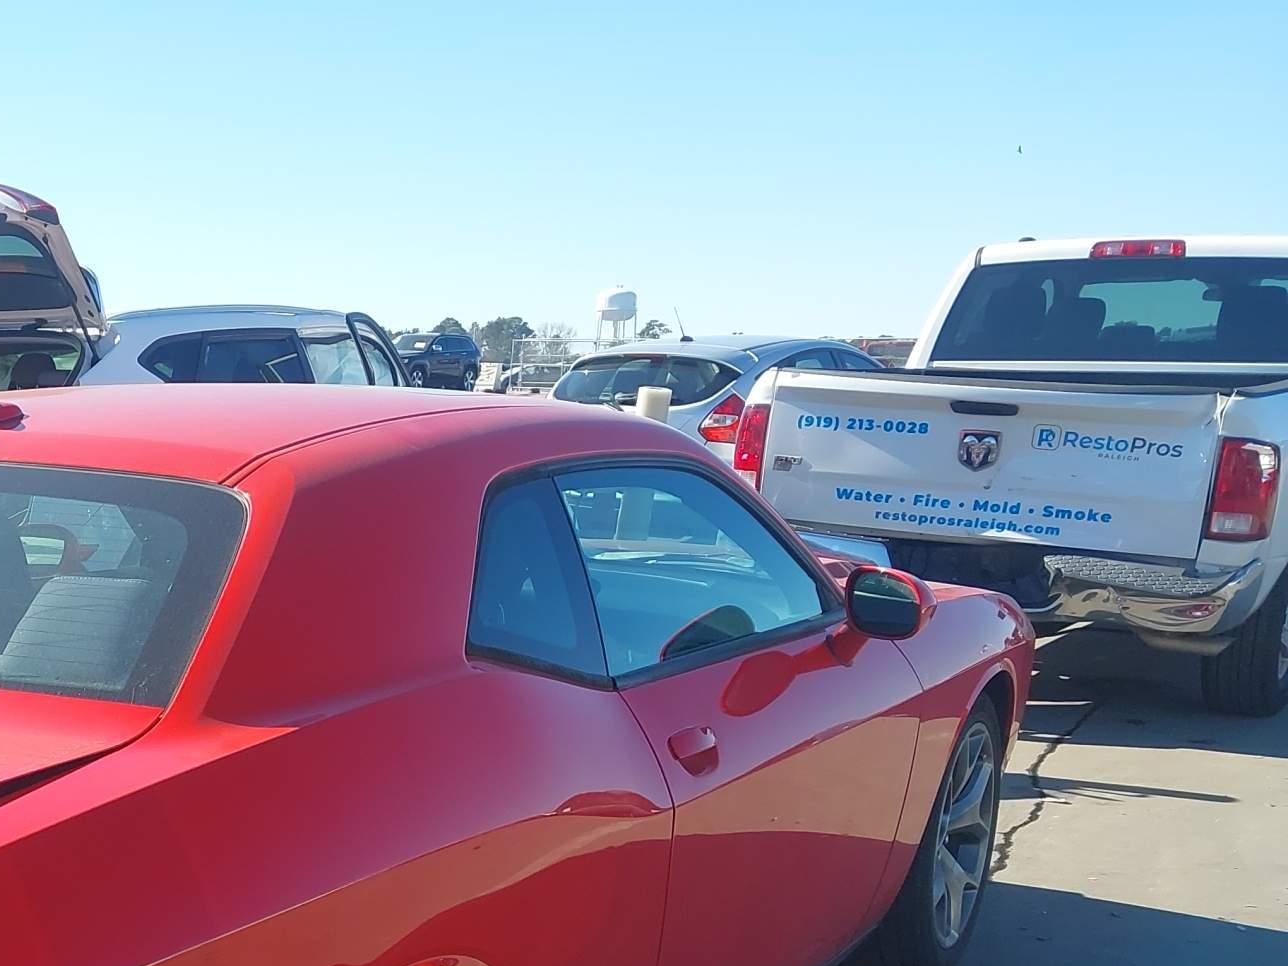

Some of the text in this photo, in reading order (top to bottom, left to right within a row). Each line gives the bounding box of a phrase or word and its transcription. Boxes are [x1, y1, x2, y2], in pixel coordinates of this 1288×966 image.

[798, 415, 929, 434] (919) 213-0028
[1063, 431, 1183, 458] RestoPros
[836, 487, 1112, 523] Water Fire Mold Smoke
[875, 510, 1060, 536] restoprosraleigh.com
